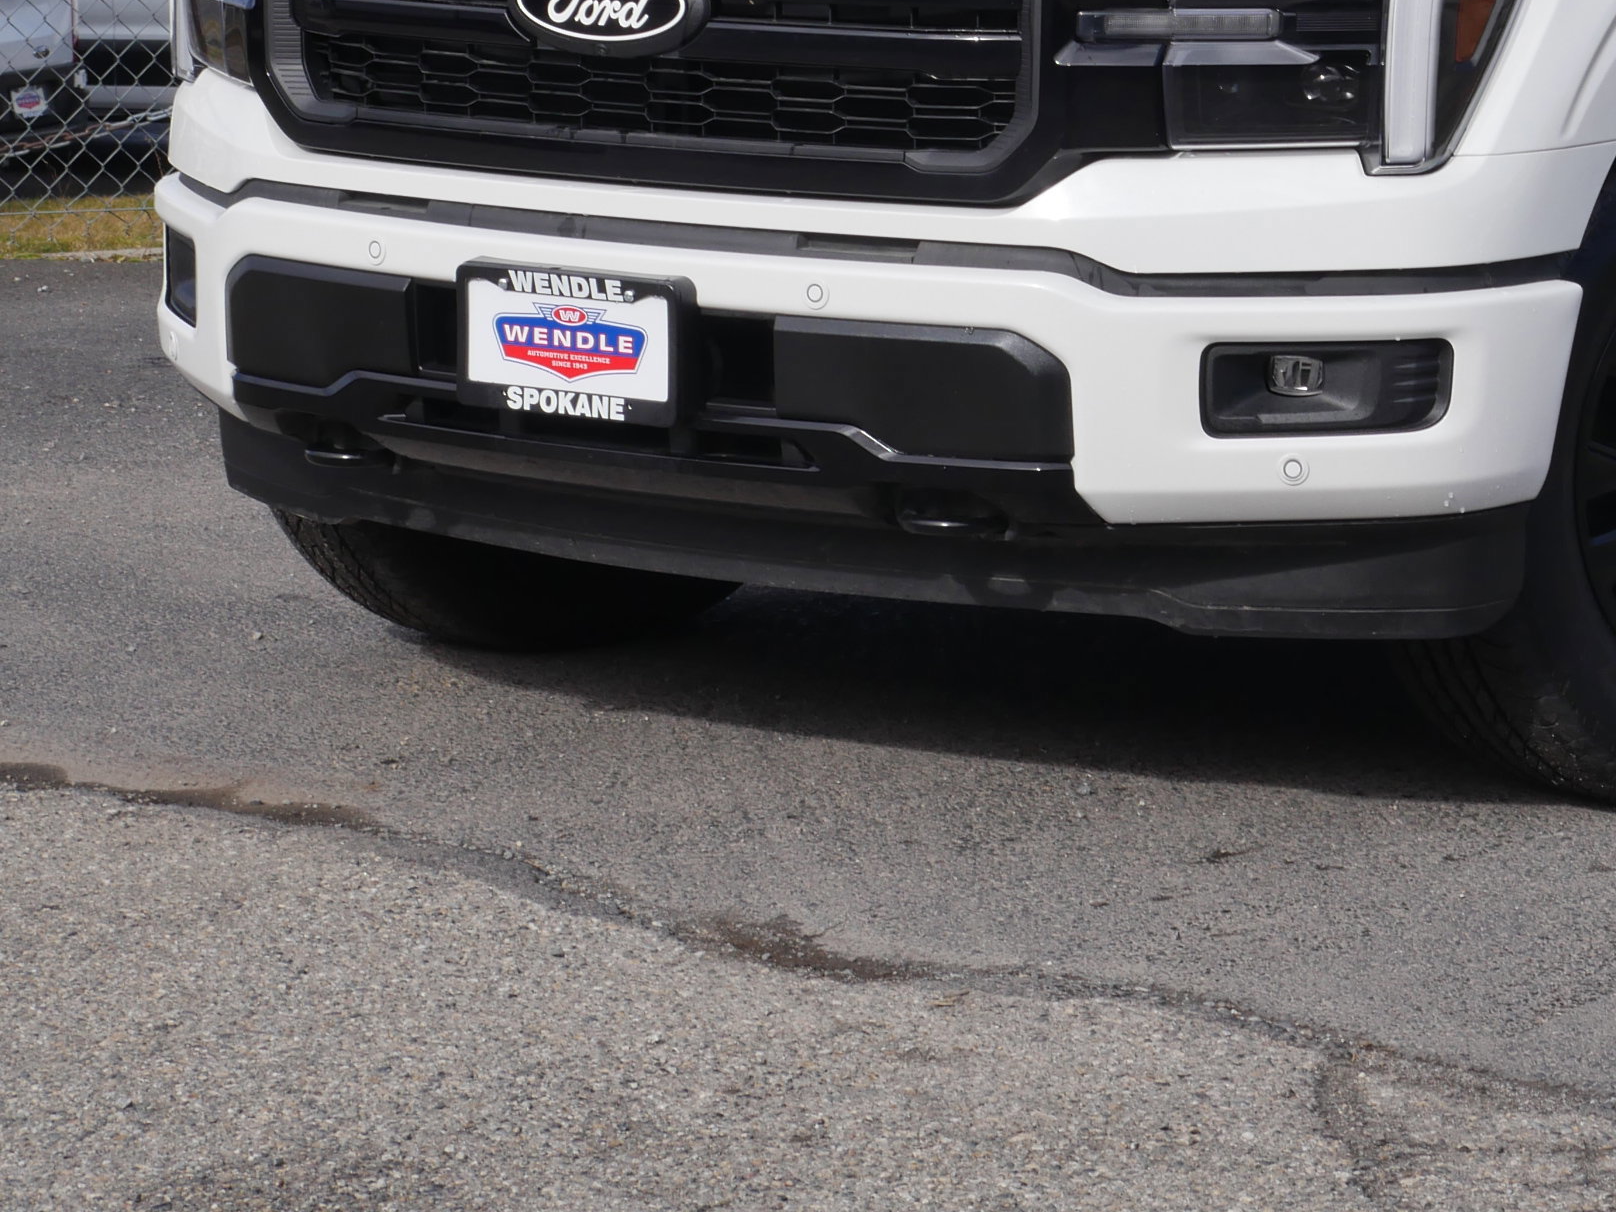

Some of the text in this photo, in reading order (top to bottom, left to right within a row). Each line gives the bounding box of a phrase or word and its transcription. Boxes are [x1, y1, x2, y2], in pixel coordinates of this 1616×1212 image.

[508, 269, 625, 303] WENDLE
[503, 324, 633, 354] WENDLE
[527, 349, 611, 364] AUTOMOTIVE EXCELLENCE
[551, 360, 571, 368] SINCE
[506, 385, 625, 422] SPOKANE
